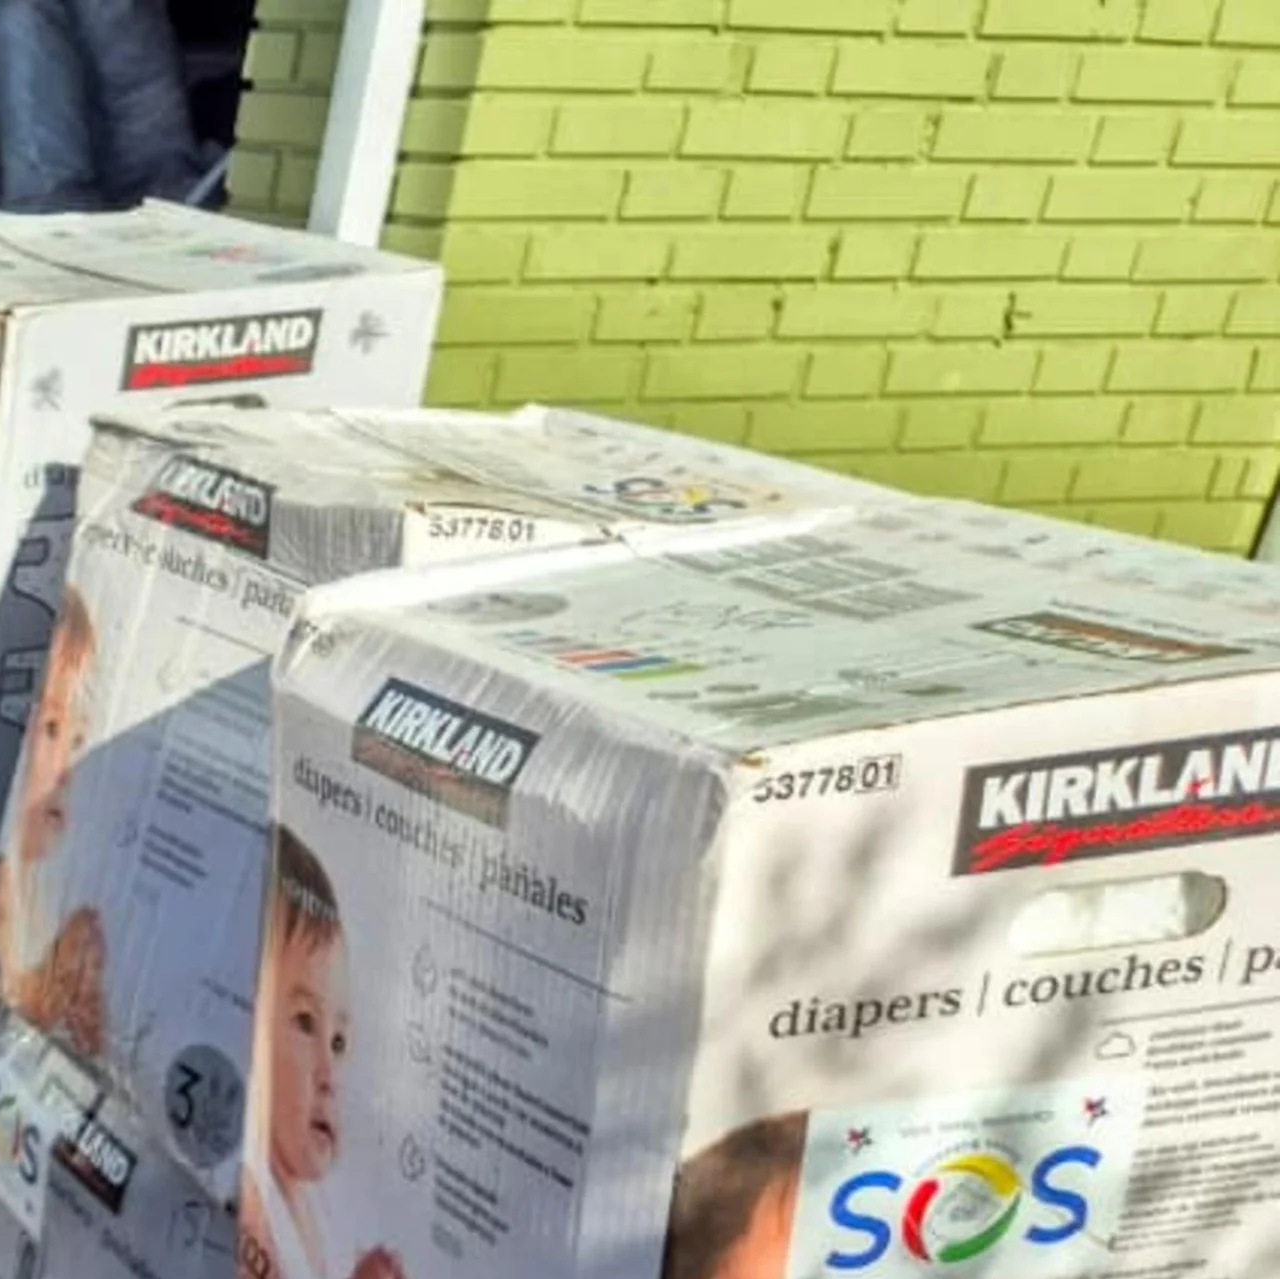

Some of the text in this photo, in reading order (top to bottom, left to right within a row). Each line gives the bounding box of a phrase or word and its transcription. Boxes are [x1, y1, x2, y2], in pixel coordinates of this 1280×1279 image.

[133, 315, 315, 365] KIRKLAND
[368, 688, 523, 785] KIRKLAND
[767, 985, 963, 1041] diapers
[1003, 951, 1206, 1008] couches
[825, 1145, 1104, 1271] SOS
